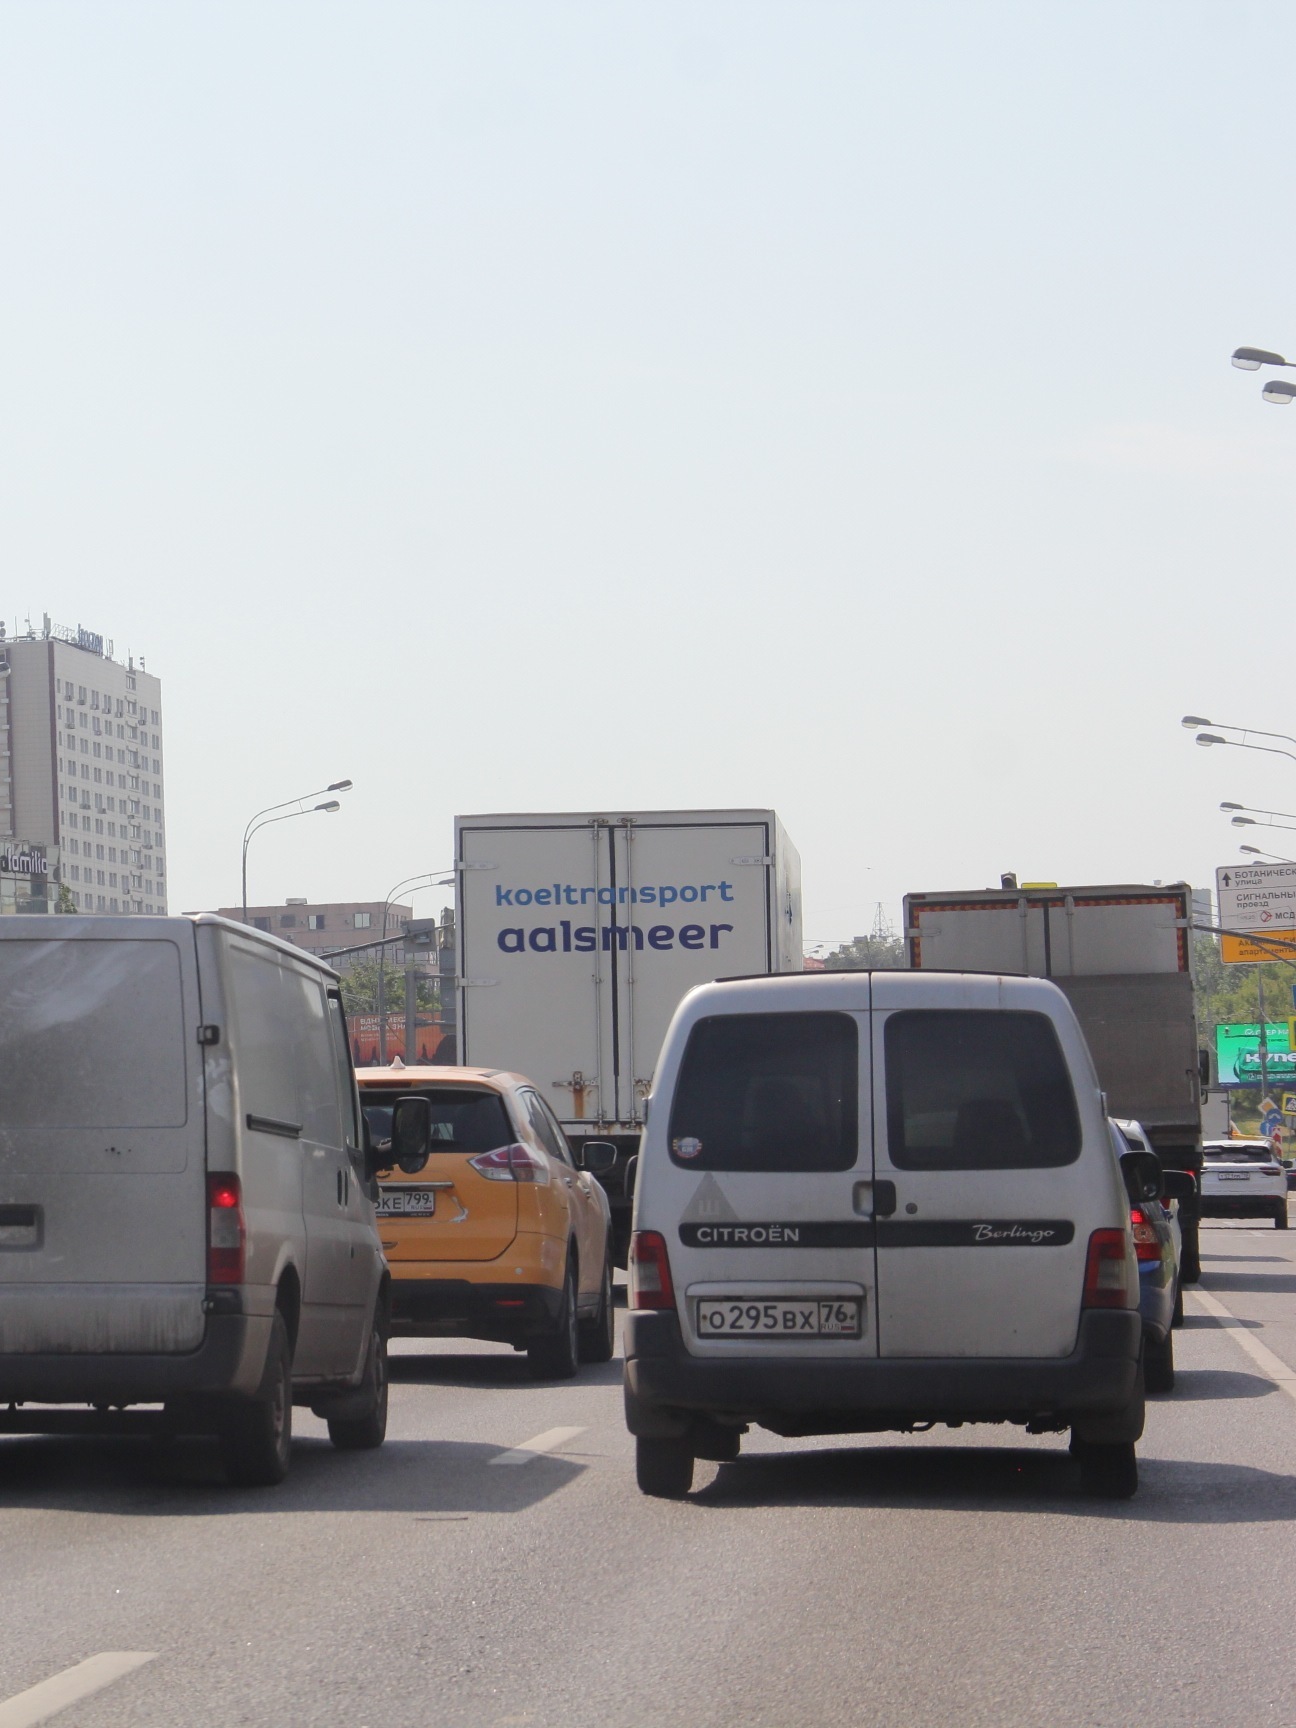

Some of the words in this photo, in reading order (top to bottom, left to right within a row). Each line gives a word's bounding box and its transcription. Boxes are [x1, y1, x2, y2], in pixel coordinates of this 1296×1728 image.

[7, 846, 49, 874] familia
[1235, 878, 1263, 887] улица
[495, 880, 734, 908] koeltransport
[1236, 901, 1269, 911] проезд
[497, 920, 734, 953] aalsmeer
[405, 1192, 430, 1205] 799
[696, 1224, 800, 1242] CITROËN
[971, 1223, 1055, 1243] Berlingo
[709, 1305, 815, 1330] О295ВХ
[821, 1303, 849, 1323] 76
[820, 1323, 842, 1331] RUS
